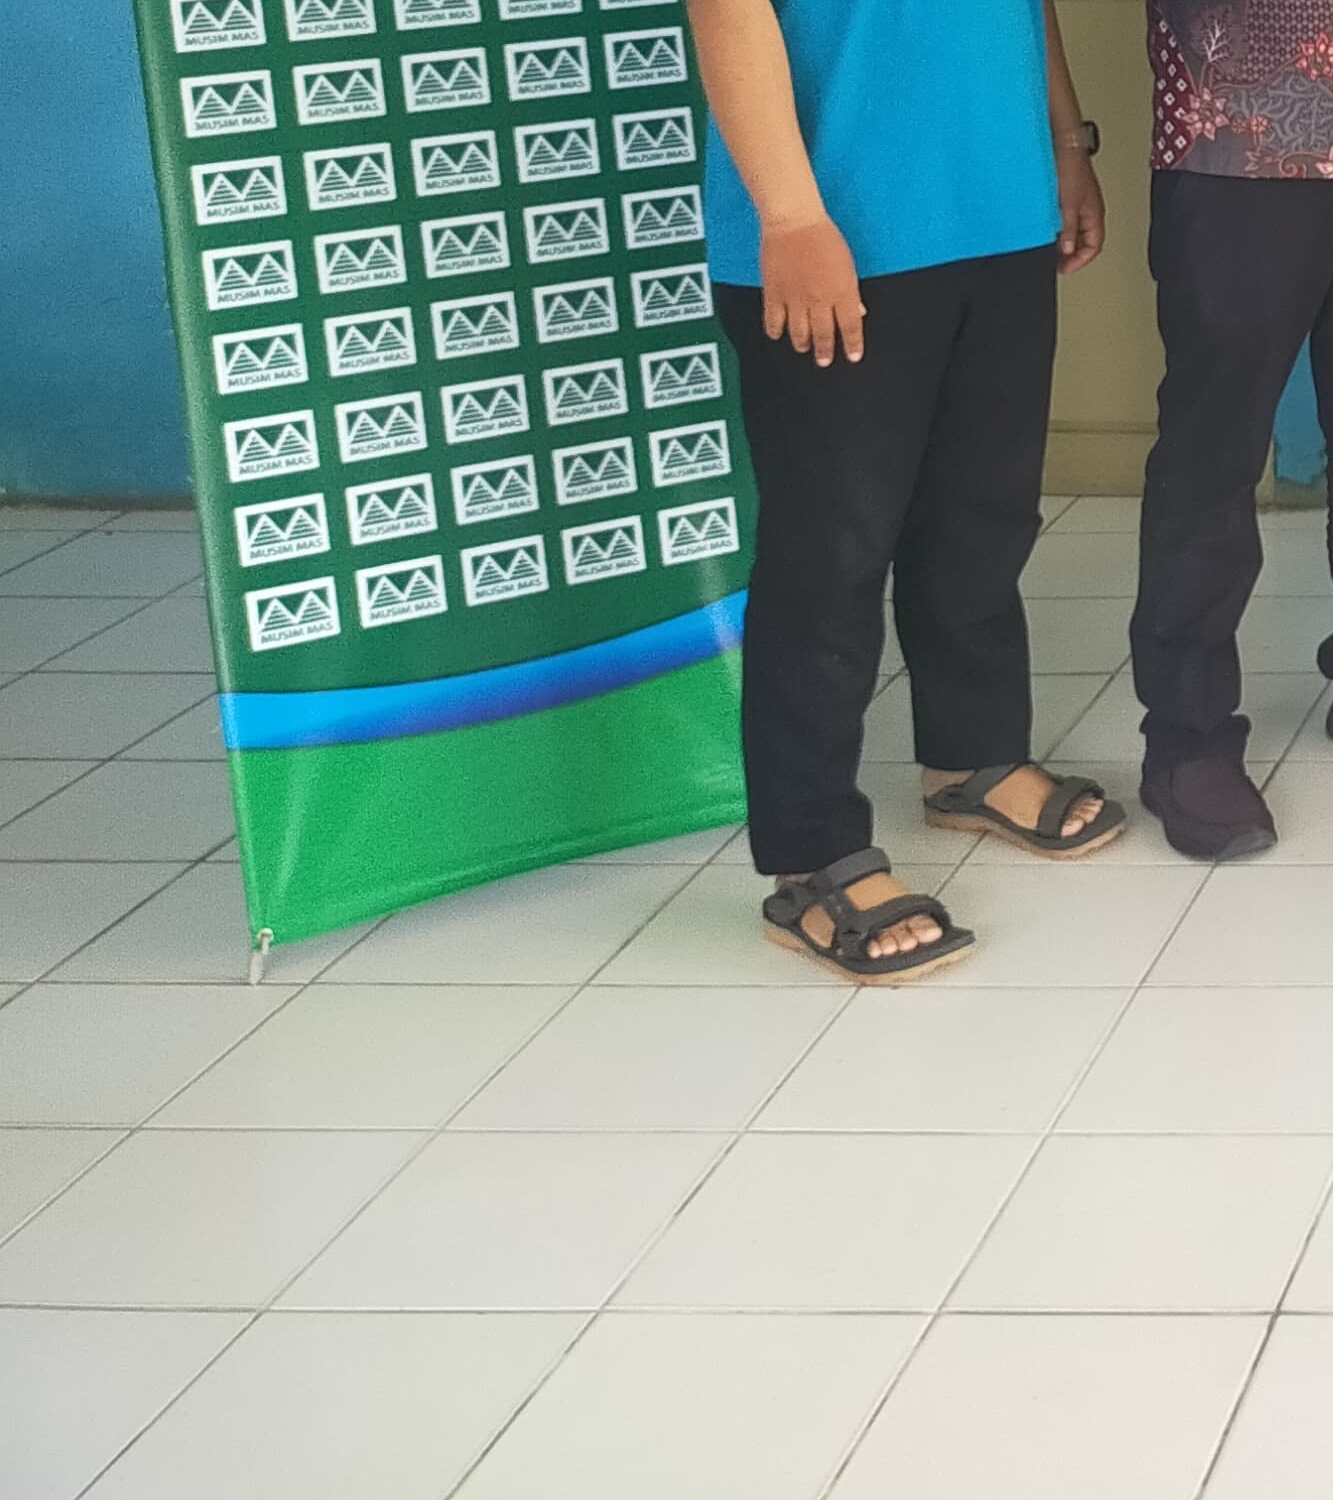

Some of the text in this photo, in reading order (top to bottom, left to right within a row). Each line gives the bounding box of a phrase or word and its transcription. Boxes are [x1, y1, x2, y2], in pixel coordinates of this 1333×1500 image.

[184, 30, 259, 48] MUSIM MAS
[194, 113, 271, 131] MUSIM MAS
[205, 200, 281, 220] MUSIM MAS
[216, 284, 291, 305] MUSIM MAS
[226, 366, 303, 387] MUSIM MAS
[238, 453, 315, 476] MUSIM MAS
[248, 537, 323, 559] MUSIM MAS
[259, 621, 332, 644] MUSIM MAS
